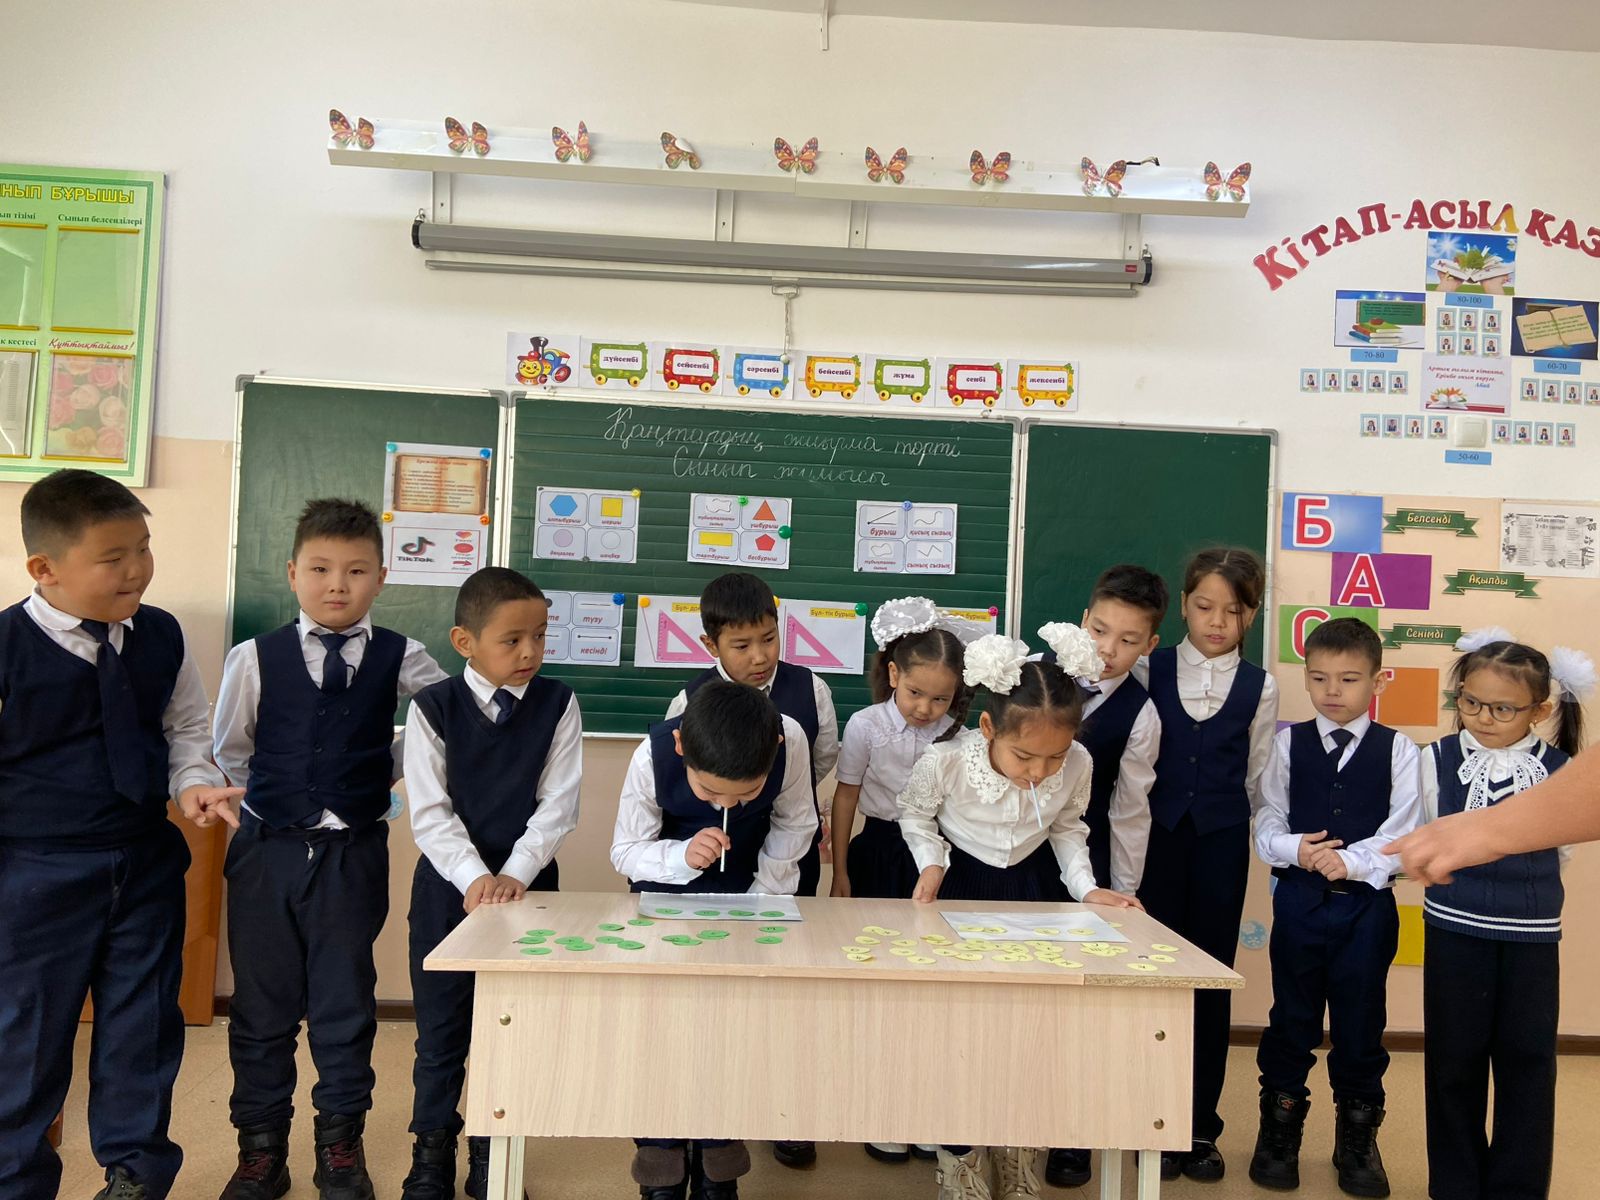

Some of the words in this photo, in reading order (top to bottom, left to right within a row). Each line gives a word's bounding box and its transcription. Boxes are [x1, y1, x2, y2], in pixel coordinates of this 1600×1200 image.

[51, 186, 135, 204] БҰРЫШЫ
[14, 212, 36, 220] тізімі
[58, 214, 90, 222] Сынып
[91, 216, 142, 226] белсенділері
[1252, 199, 1520, 291] КІТАП-АСЫЛ
[8, 338, 37, 346] кестесі
[48, 338, 135, 350] Құттықтаймыз!
[602, 356, 639, 364] дүйсенбі
[676, 362, 710, 370] сейсенбі
[746, 366, 780, 374] сәрсенбі
[818, 368, 852, 376] бейсенбі
[1030, 376, 1065, 384] жексенбі
[673, 445, 758, 478] Сынып
[1293, 494, 1334, 547] Б
[1408, 513, 1451, 524] Белсенді
[1338, 554, 1385, 607] А
[1468, 574, 1508, 585] Ақылды
[582, 615, 604, 624] түзу
[1406, 628, 1444, 639] Сенімді
[580, 646, 608, 656] кесінді
